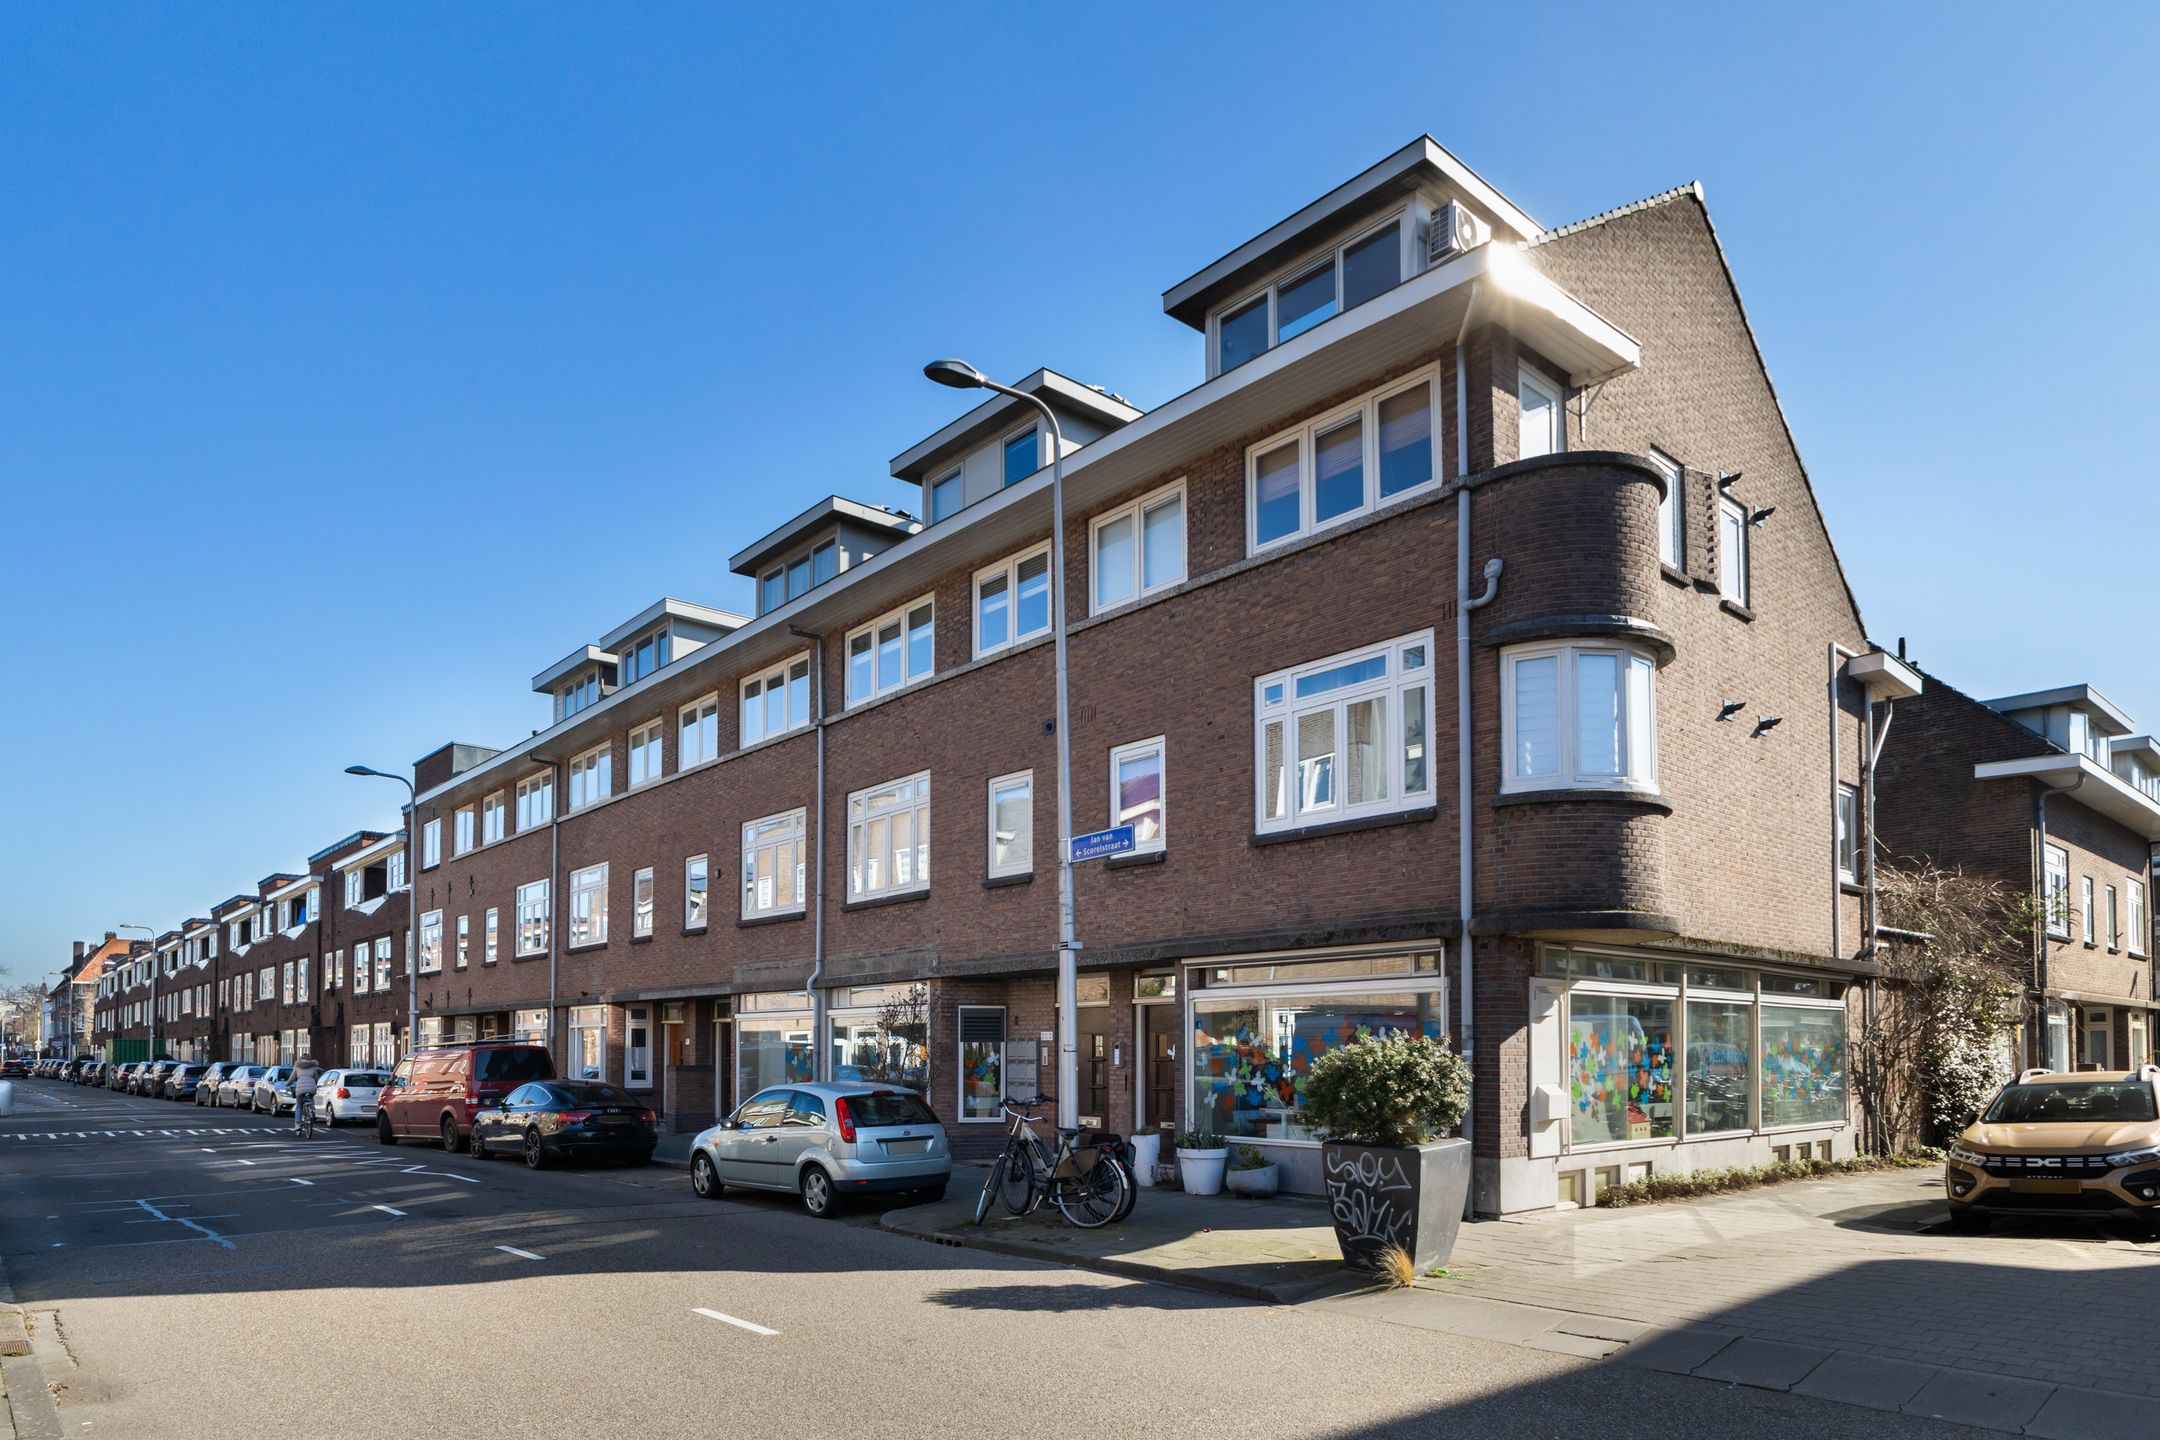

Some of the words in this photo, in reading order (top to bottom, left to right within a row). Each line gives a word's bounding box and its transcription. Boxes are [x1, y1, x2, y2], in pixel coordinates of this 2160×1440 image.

[1090, 836, 1100, 844] Jan
[1102, 833, 1113, 841] van
[1083, 841, 1121, 855] Scorelstraat
